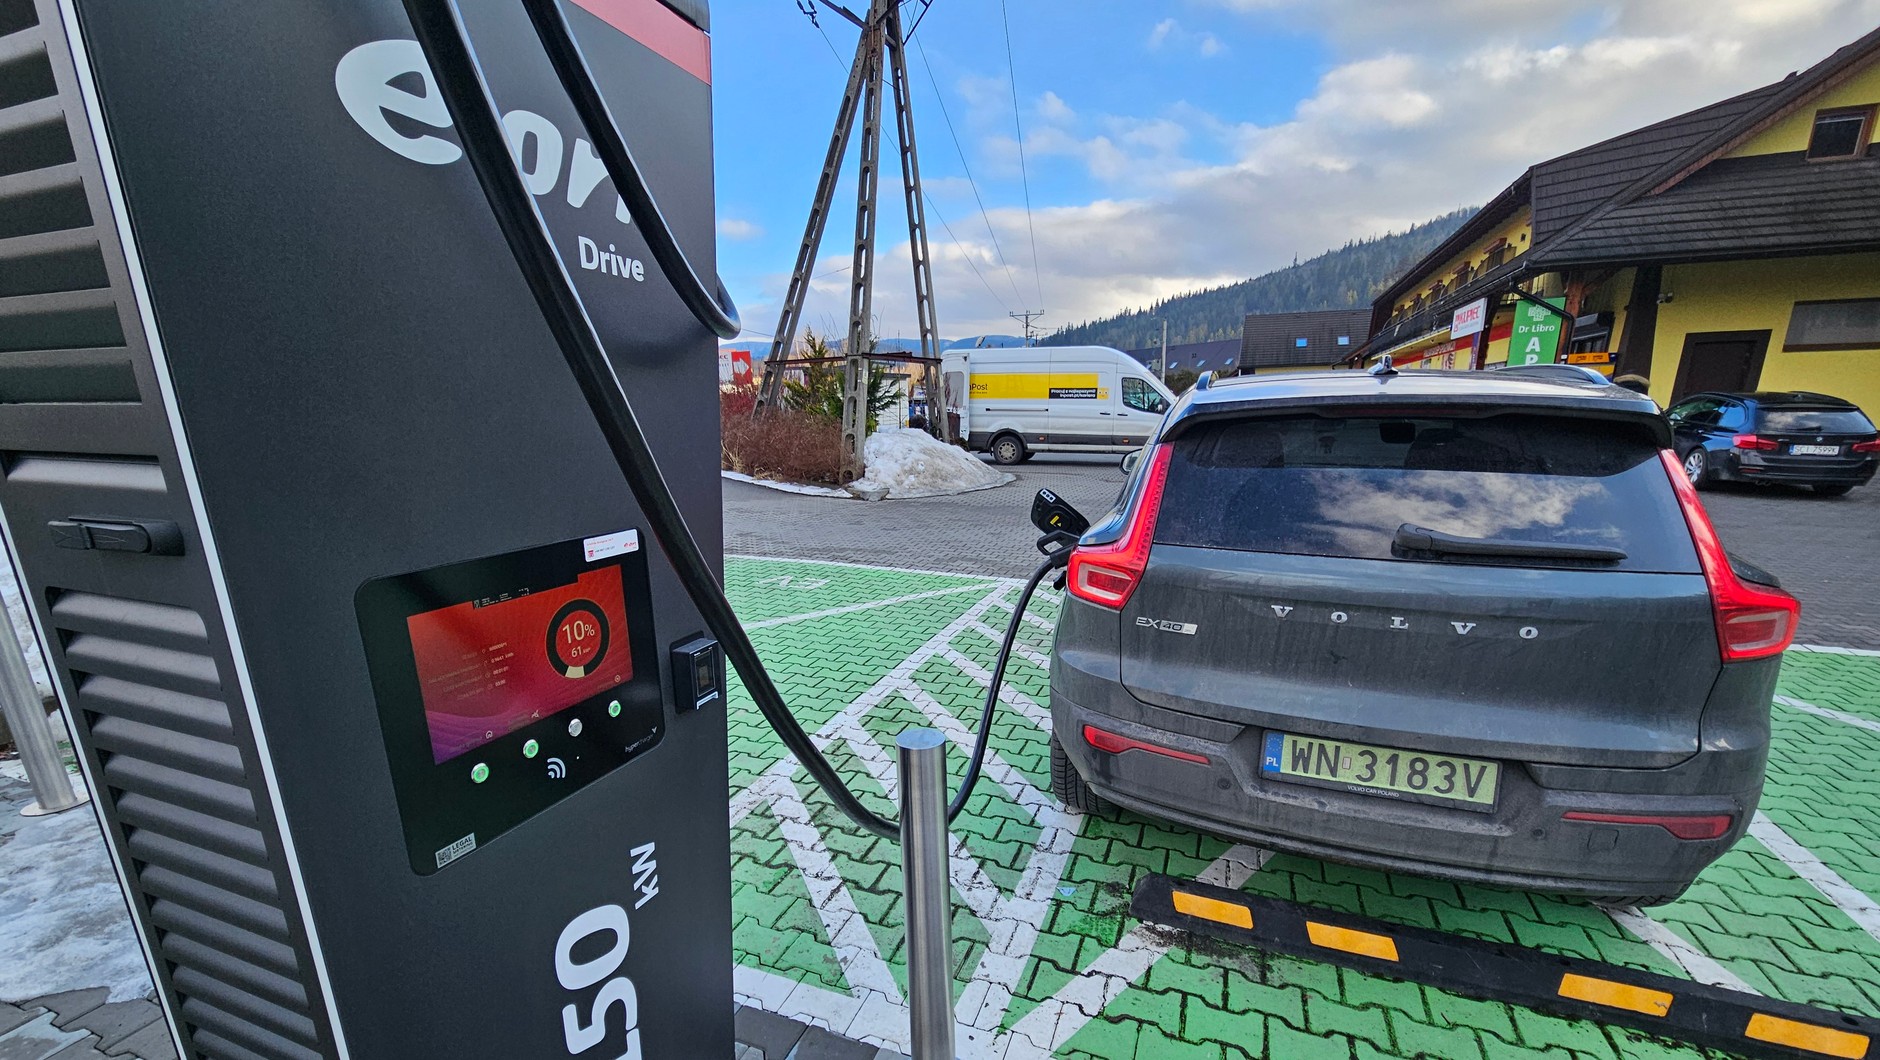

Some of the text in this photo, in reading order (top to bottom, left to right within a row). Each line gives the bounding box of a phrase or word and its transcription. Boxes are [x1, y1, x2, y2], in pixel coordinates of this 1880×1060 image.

[577, 235, 645, 282] Drive
[1518, 324, 1555, 333] Dr Libro
[562, 620, 595, 644] 10%
[1271, 604, 1539, 640] VOLVO
[571, 646, 582, 658] 61
[1265, 739, 1488, 799] PL WN 3183V
[1347, 785, 1365, 793] VOLVO
[1378, 789, 1400, 798] POLAND
[451, 836, 473, 851] LEGAL
[630, 842, 659, 910] kW
